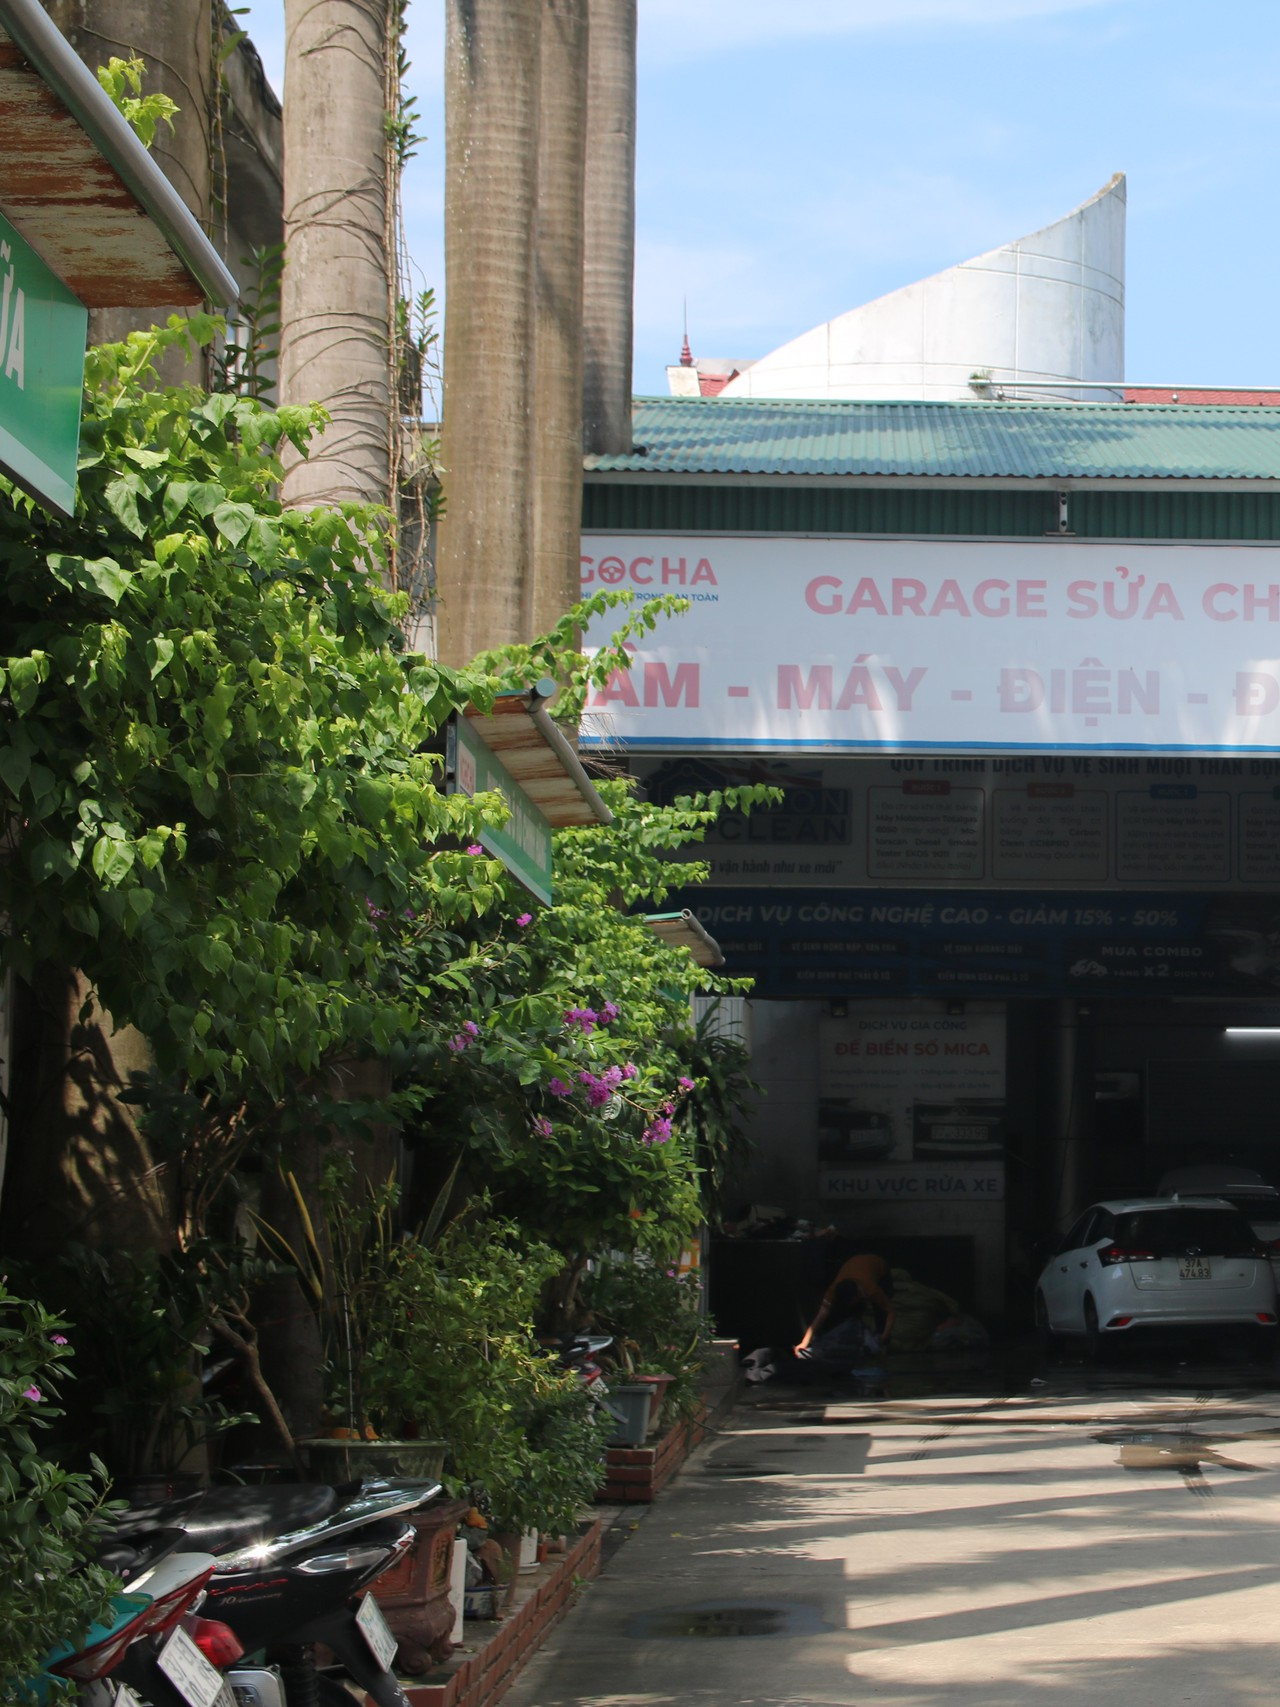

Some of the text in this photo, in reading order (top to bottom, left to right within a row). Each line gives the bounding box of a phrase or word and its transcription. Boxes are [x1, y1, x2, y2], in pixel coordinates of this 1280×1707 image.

[580, 556, 718, 585] GOCHA
[692, 593, 718, 601] TOÀN
[805, 575, 1048, 617] GARAGE
[1066, 566, 1184, 622] SỬA
[778, 653, 927, 712] MÁY
[997, 657, 1160, 726] ĐIỆN
[719, 817, 846, 841] CLEAN
[697, 902, 1177, 927] DỊCH VỤ CÔNG NGHỆ CAO GIẢM 15% 50%
[1102, 947, 1202, 956] MUA COMBO
[944, 1043, 990, 1055] MICA
[828, 1174, 997, 1196] KHU VỰC RỬA XE
